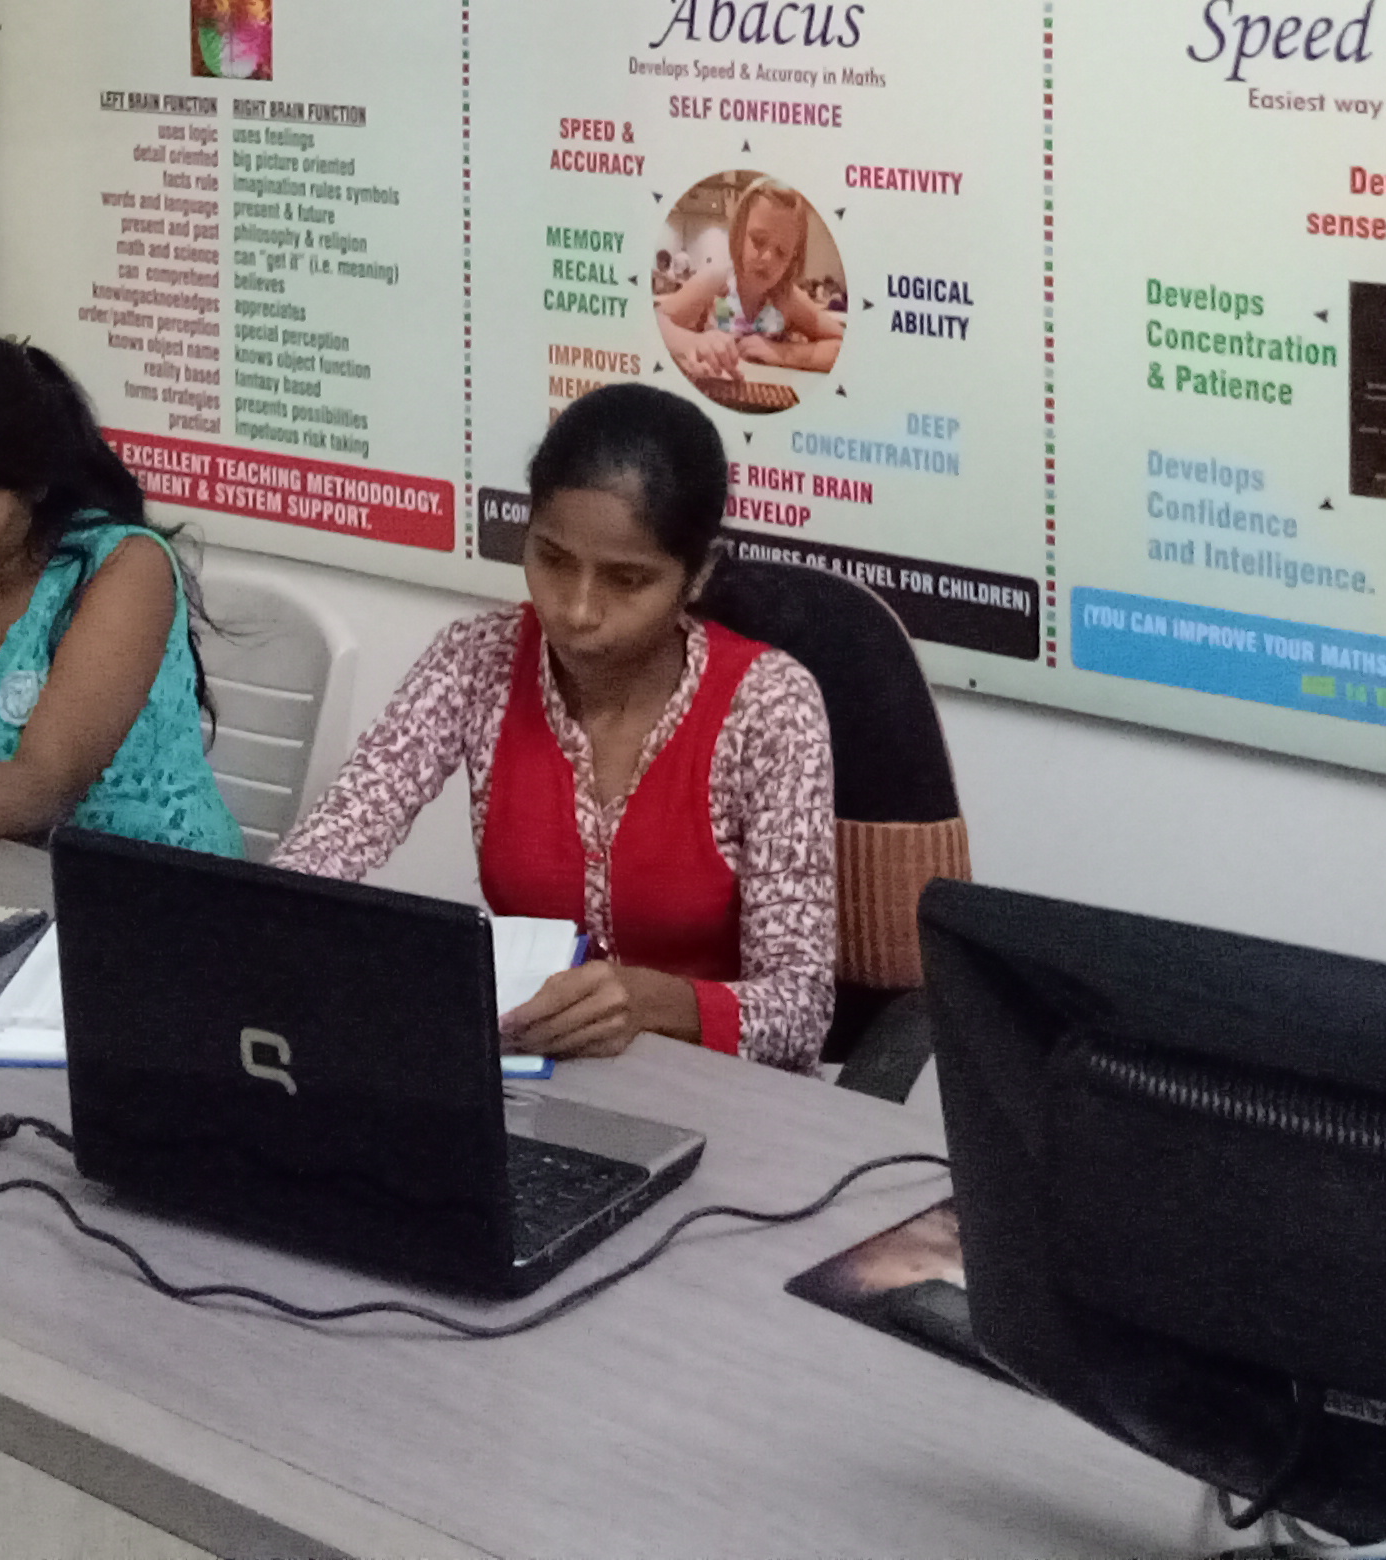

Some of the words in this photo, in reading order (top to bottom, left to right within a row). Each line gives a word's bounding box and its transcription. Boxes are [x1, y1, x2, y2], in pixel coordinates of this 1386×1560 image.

[629, 56, 689, 80] Develops
[694, 60, 734, 81] Speed
[740, 63, 750, 80] &
[756, 63, 817, 87] Accuracy
[823, 67, 836, 84] in
[842, 68, 886, 87] Maths
[101, 91, 128, 111] LEFT
[128, 93, 159, 109] BRAIN
[164, 95, 217, 115] FUNCTION
[233, 99, 266, 121] RIGHT
[270, 101, 304, 120] BRAIN
[308, 104, 366, 127] FUNCTION
[670, 95, 711, 119] SELF
[720, 99, 841, 127] CONFIDENCE
[1249, 88, 1325, 111] Easiest
[1335, 100, 1383, 119] way
[560, 118, 615, 142] SPEED
[622, 122, 634, 143] &
[551, 150, 645, 176] ACCURACY
[846, 165, 962, 195] CREATIVITY
[547, 226, 624, 253] MEMORY
[1307, 213, 1386, 240] sense
[553, 259, 618, 285] RECALL
[544, 289, 628, 318] CAPACITY
[888, 275, 974, 305] LOGICAL
[1147, 279, 1264, 320] Develops
[891, 310, 969, 340] ABILITY
[1147, 320, 1337, 367] Concentration
[1147, 362, 1165, 390] &
[1176, 365, 1292, 405] Patience
[908, 413, 959, 439] DEEP
[793, 432, 960, 475] CONCENTRATION
[124, 444, 210, 474] EXCELLENT
[217, 459, 300, 490] TEACHING
[308, 474, 443, 519] METHODOLOGY.
[748, 465, 805, 493] RIGHT
[813, 475, 872, 504] BRAIN
[846, 559, 895, 589] LEVEL
[901, 570, 933, 594] FOR
[939, 576, 1030, 616] CHILDREN)
